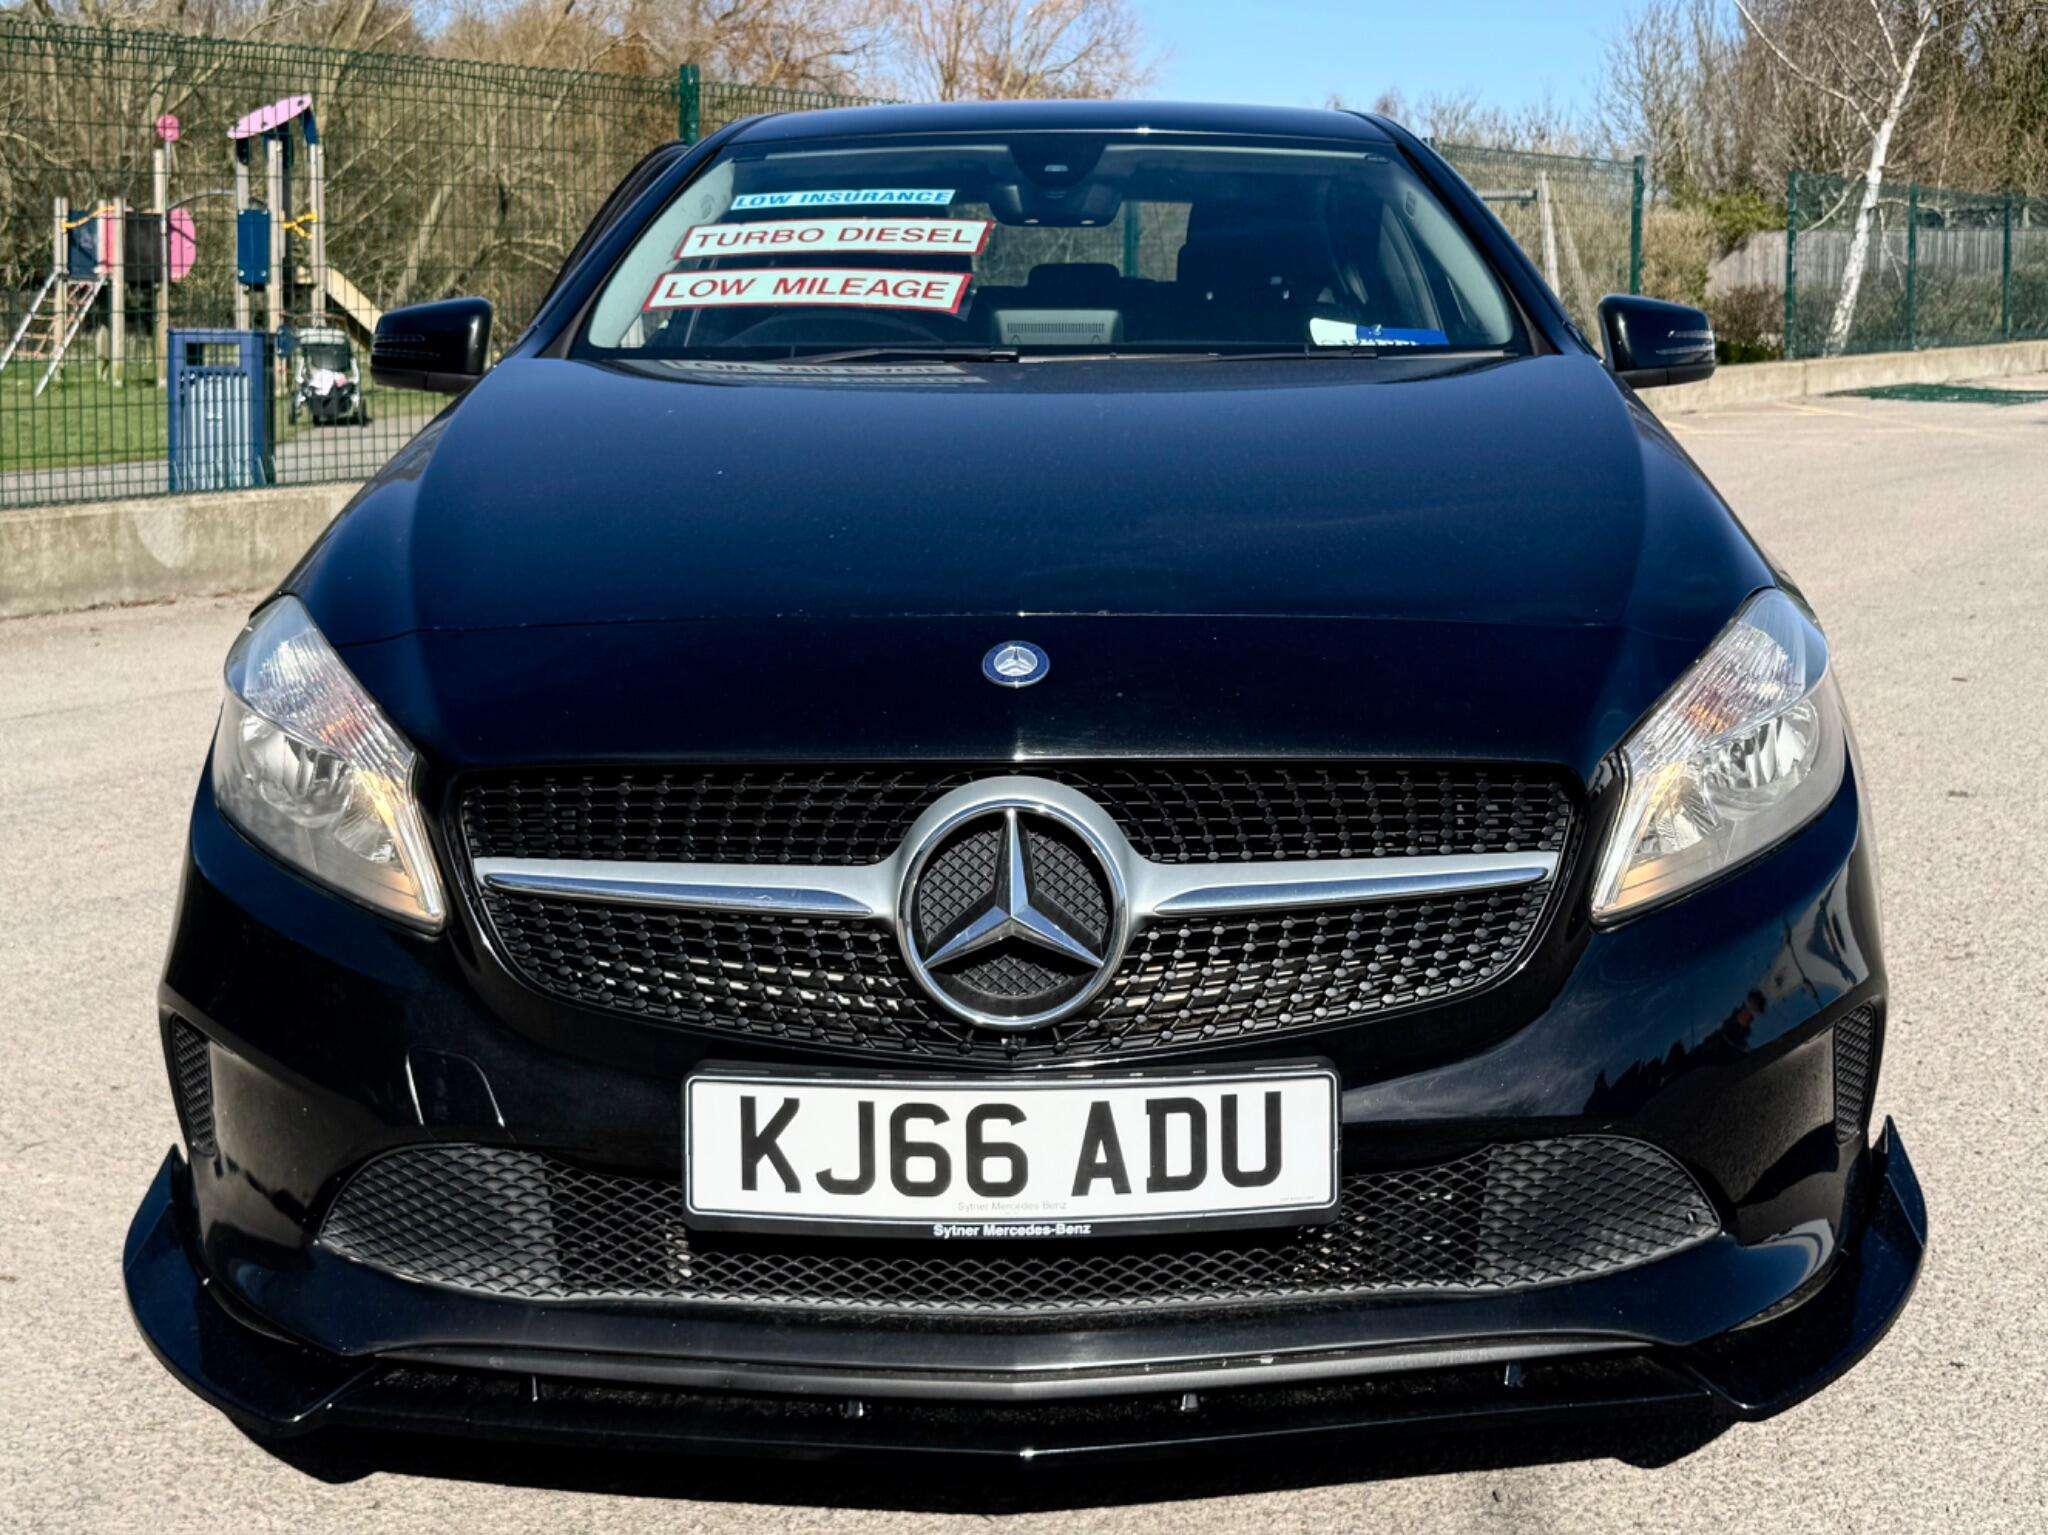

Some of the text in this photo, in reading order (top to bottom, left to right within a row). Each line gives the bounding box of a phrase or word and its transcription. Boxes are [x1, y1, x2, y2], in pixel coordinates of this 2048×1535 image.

[737, 190, 951, 207] LOW INSURANCE
[697, 227, 972, 247] TURBO DIESEL
[665, 277, 950, 299] LOW MILEAGE
[739, 1091, 1283, 1198] KJ66 ADU
[933, 1223, 1091, 1238] Sytner Mercedes-Benz
